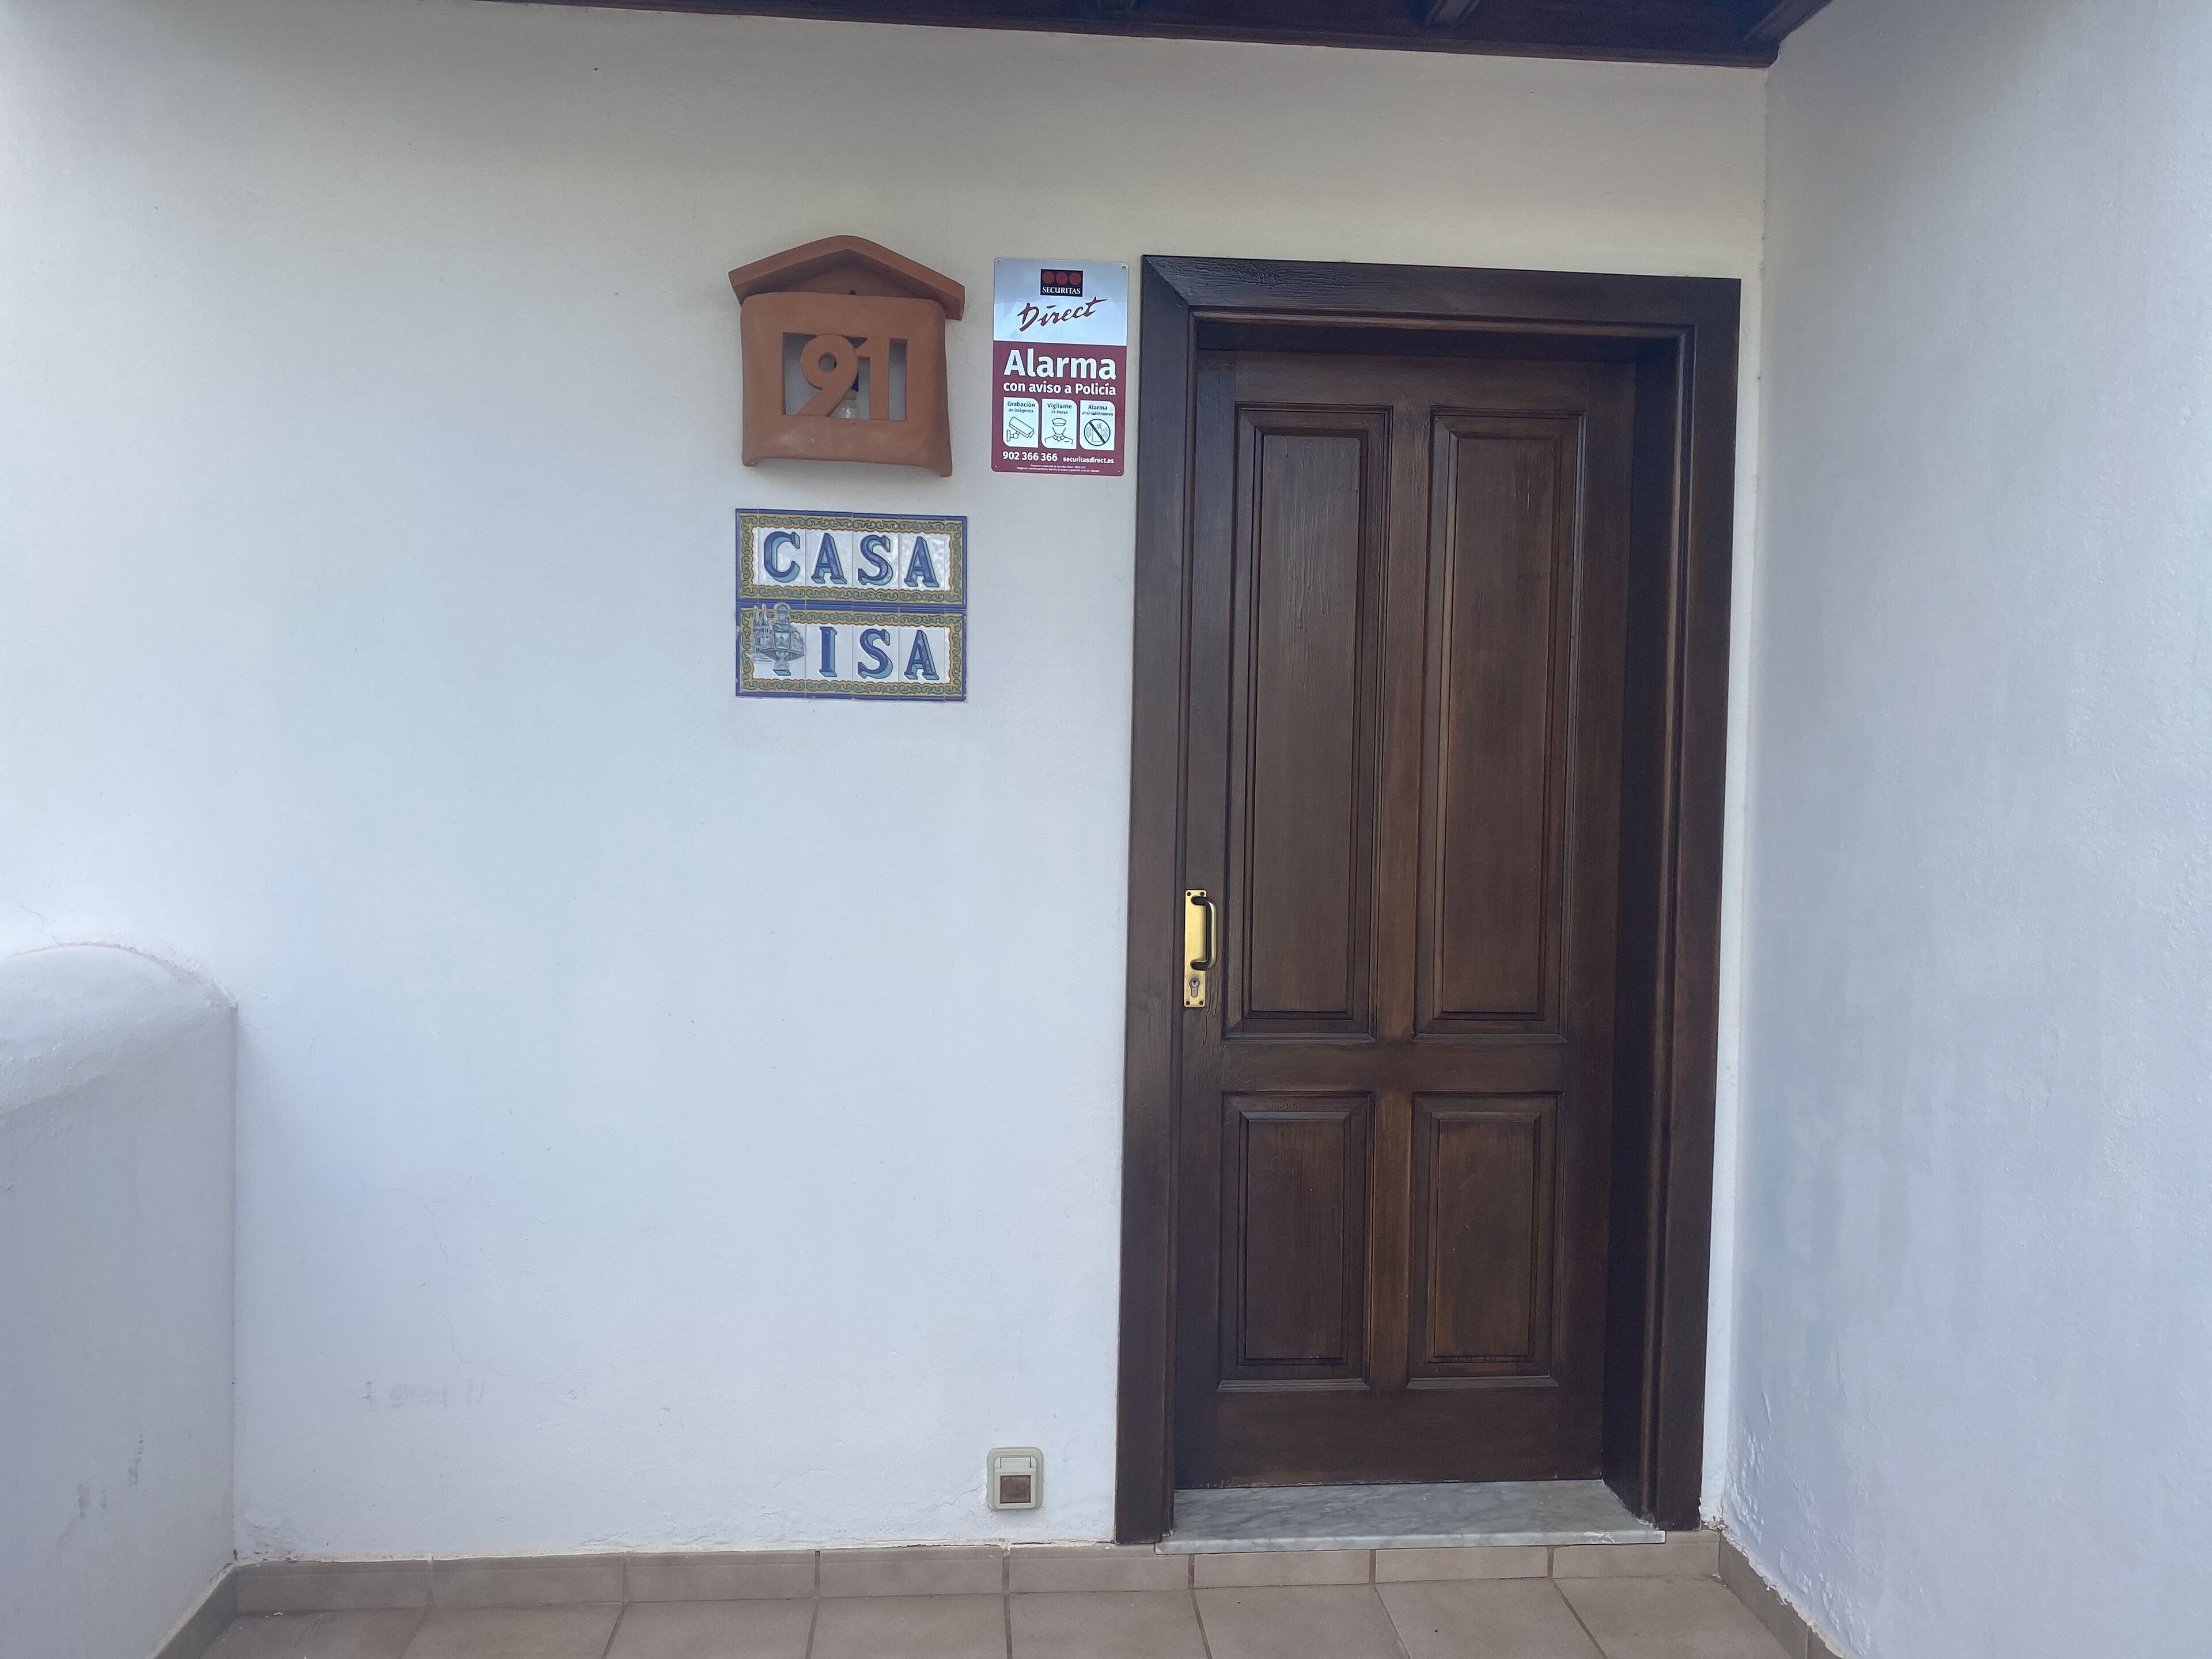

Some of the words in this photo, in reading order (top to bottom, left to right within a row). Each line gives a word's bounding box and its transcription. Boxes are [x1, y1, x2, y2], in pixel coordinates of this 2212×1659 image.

[1042, 286, 1081, 294] SECURITAS
[1017, 296, 1108, 332] Direct
[797, 334, 891, 420] 91
[1003, 348, 1116, 380] Alarma
[1003, 382, 1025, 392] con
[1028, 380, 1061, 393] aviso
[1064, 385, 1072, 394] a
[1075, 382, 1116, 396] Policía
[1002, 451, 1020, 460] 902
[1021, 452, 1039, 461] 366
[1040, 453, 1058, 461] 366
[763, 531, 940, 588] CASA
